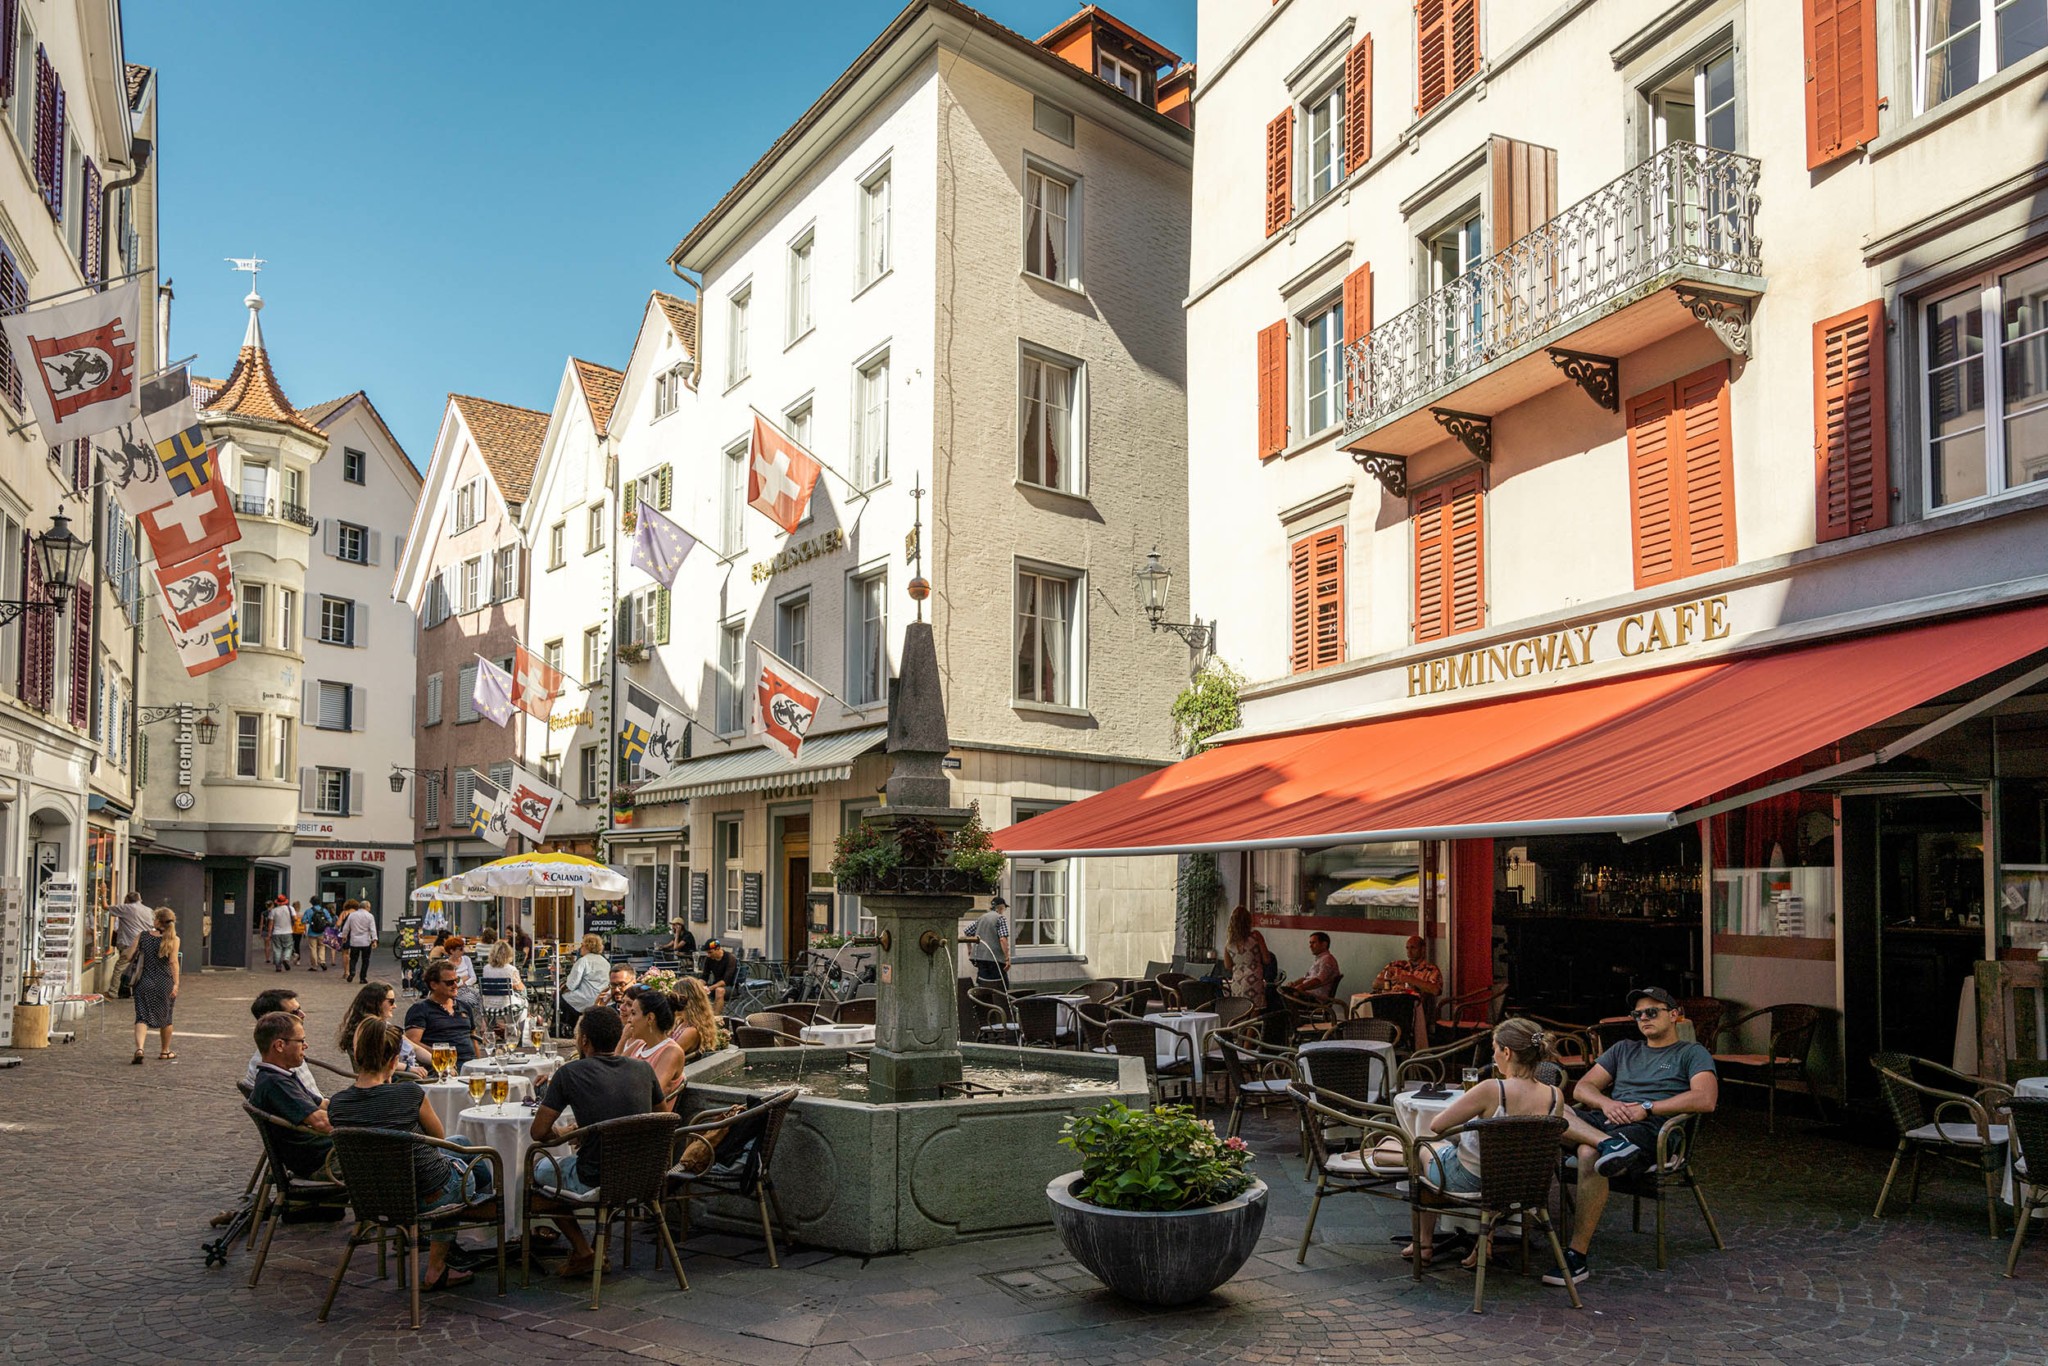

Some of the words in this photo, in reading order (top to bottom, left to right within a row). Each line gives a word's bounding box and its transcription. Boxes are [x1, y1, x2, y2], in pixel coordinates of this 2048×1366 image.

[1407, 625, 1598, 698] HEMINGWAY
[1617, 595, 1731, 657] CAFE
[175, 701, 194, 786] membrini
[296, 823, 318, 832] RBEIT
[315, 848, 355, 861] STREET
[361, 850, 386, 862] CAFE
[550, 872, 583, 882] CALANDA
[1377, 906, 1420, 918] HEMINGW
